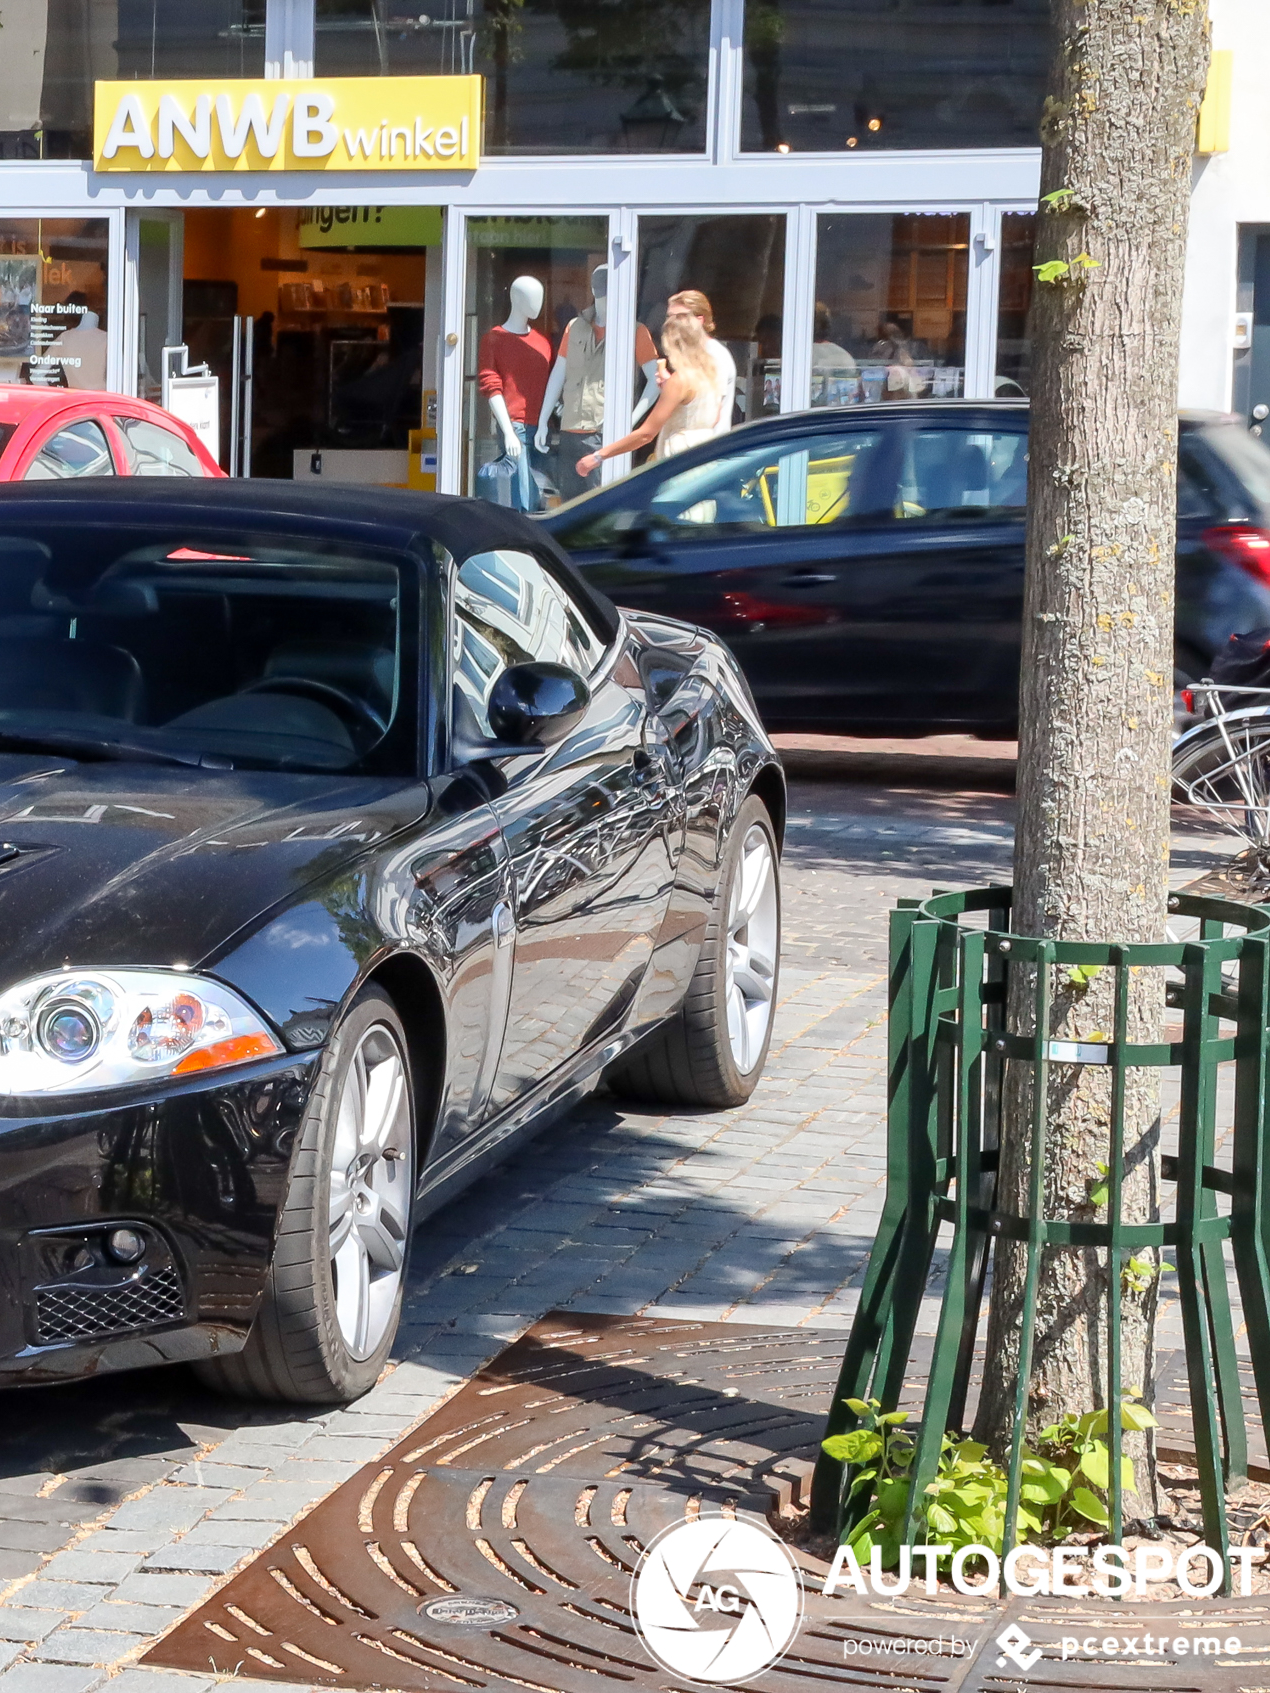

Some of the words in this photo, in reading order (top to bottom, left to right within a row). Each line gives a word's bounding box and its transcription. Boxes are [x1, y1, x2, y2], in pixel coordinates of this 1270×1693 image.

[102, 93, 338, 159] ANWB
[342, 116, 469, 157] winkel
[30, 303, 55, 314] Naar
[56, 302, 88, 314] buiten
[29, 354, 82, 368] Onderweg
